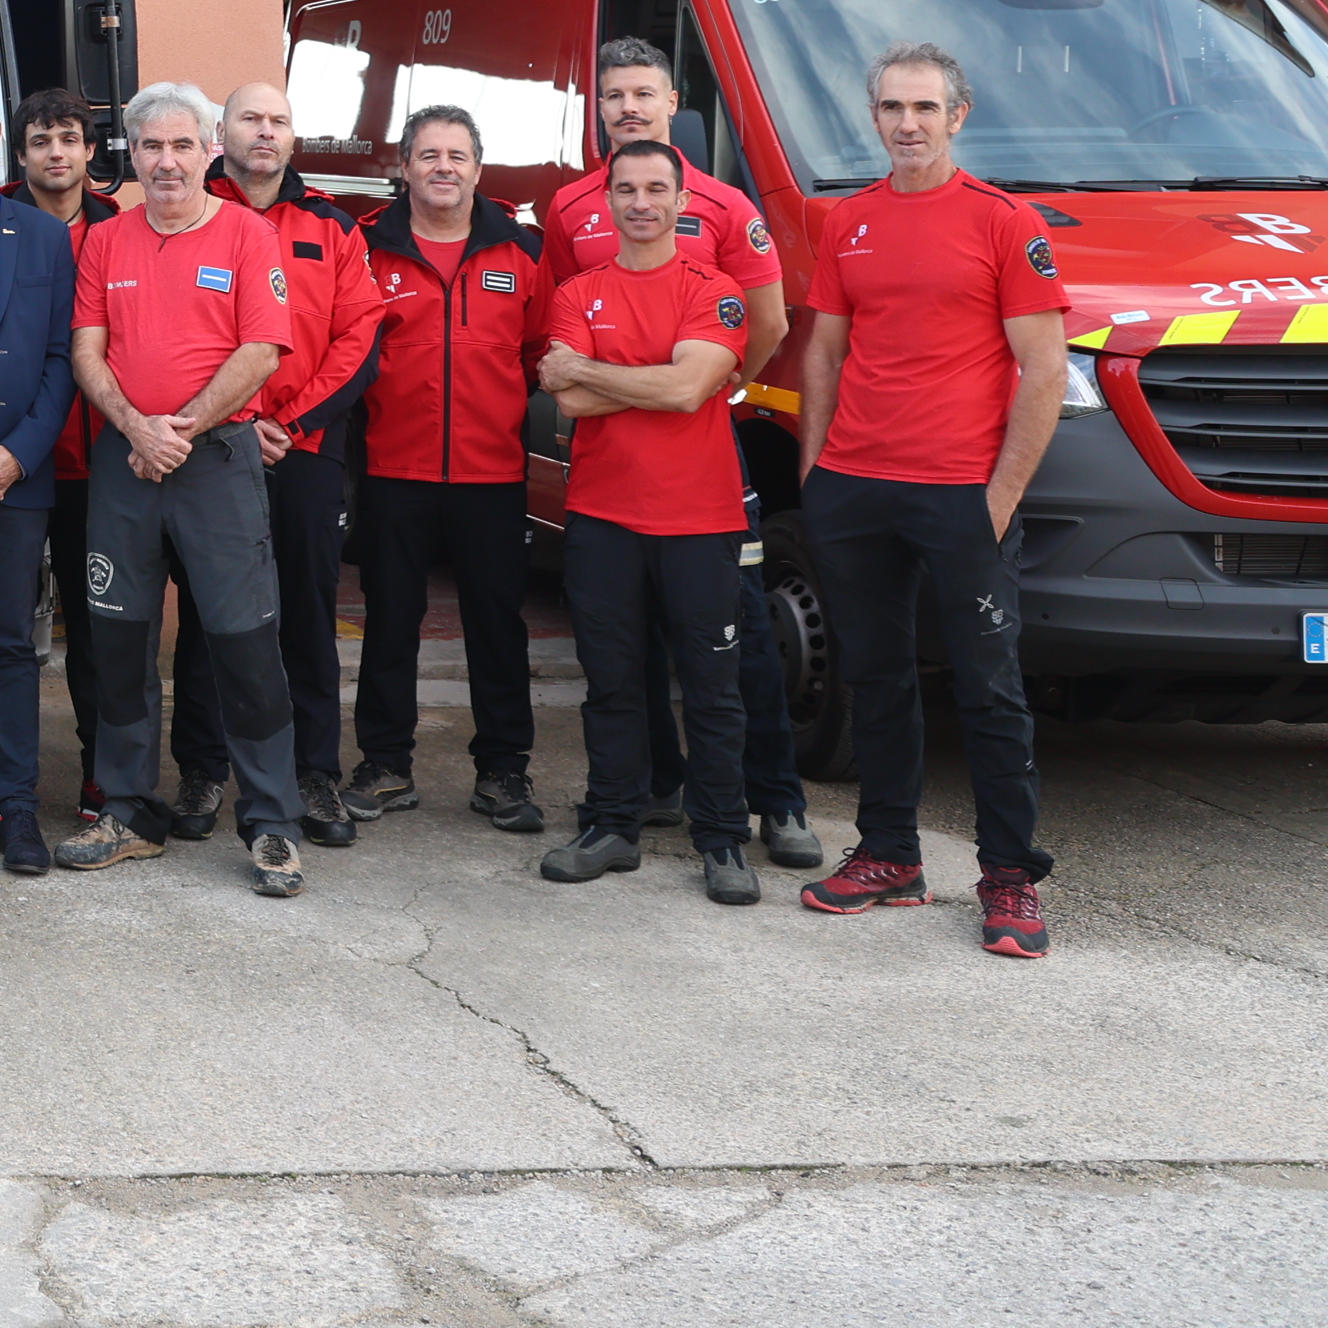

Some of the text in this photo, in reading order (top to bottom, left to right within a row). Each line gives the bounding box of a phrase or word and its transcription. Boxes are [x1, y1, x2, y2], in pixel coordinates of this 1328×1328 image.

[422, 9, 452, 45] 809
[331, 139, 340, 153] de
[341, 134, 373, 155] Mallorca
[94, 601, 124, 611] MALLORCA
[1310, 643, 1321, 654] E
